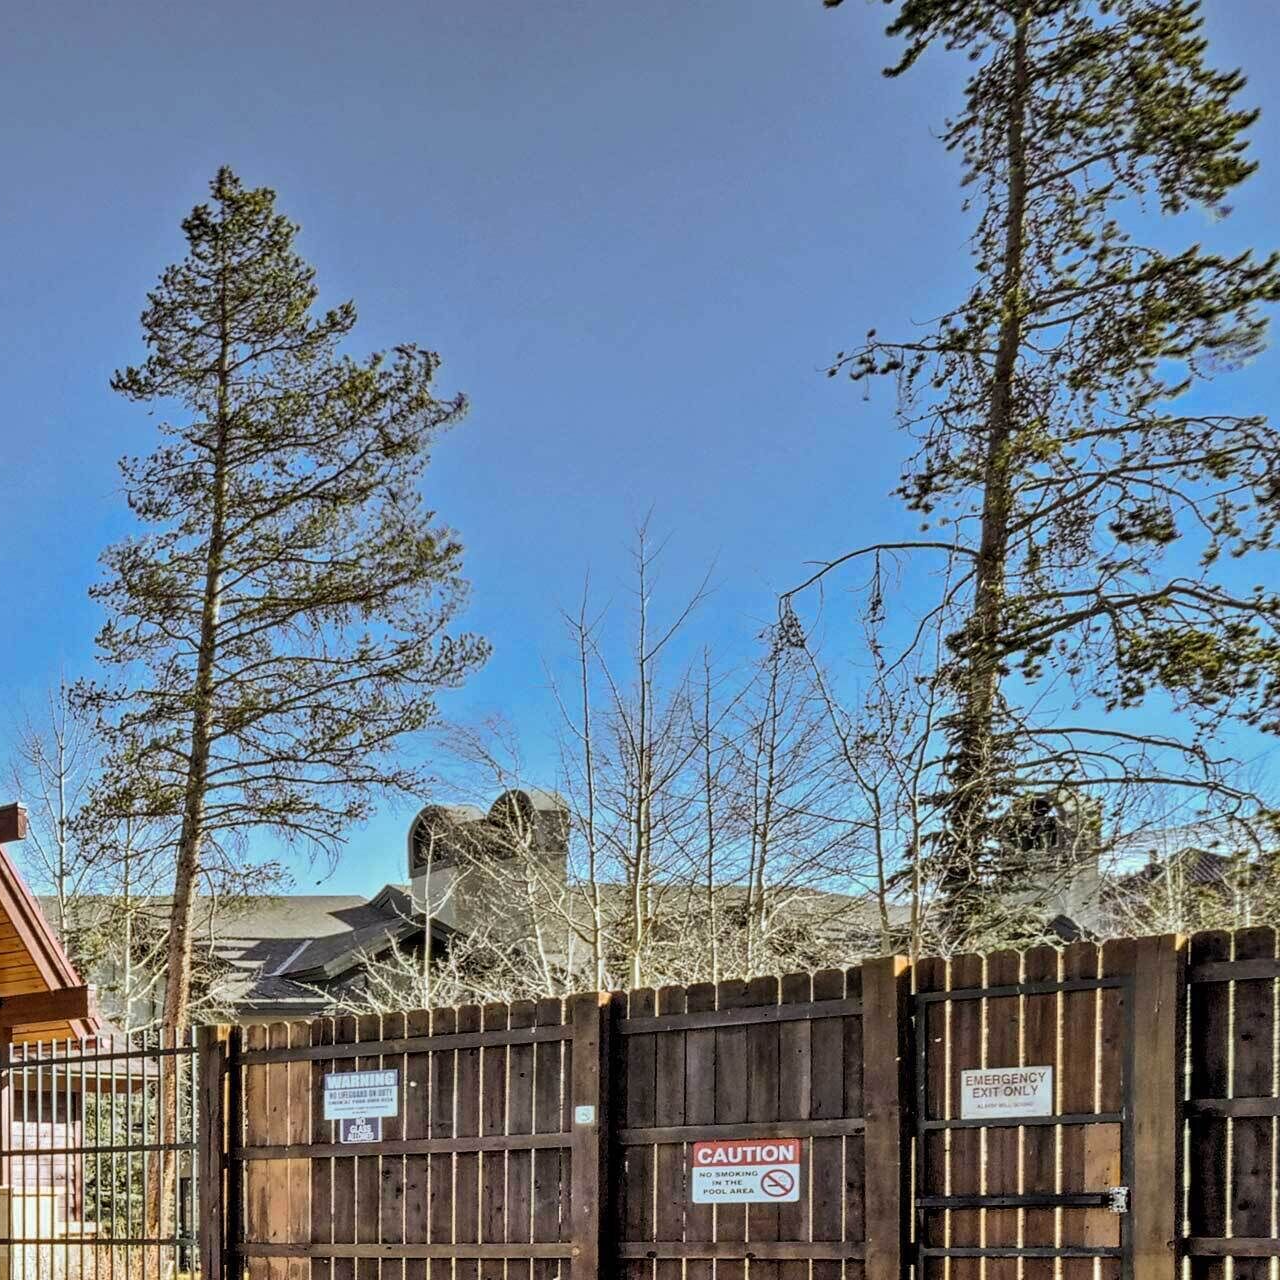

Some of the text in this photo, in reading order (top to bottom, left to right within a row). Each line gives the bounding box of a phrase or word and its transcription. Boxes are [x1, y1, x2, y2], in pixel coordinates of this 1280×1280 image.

[327, 1072, 395, 1089] WARNING
[966, 1072, 1046, 1086] EMERGENCY
[972, 1085, 1038, 1098] EXIT ONLY
[355, 1117, 366, 1125] NO
[350, 1124, 372, 1133] GLASS
[697, 1145, 794, 1164] CAUTION
